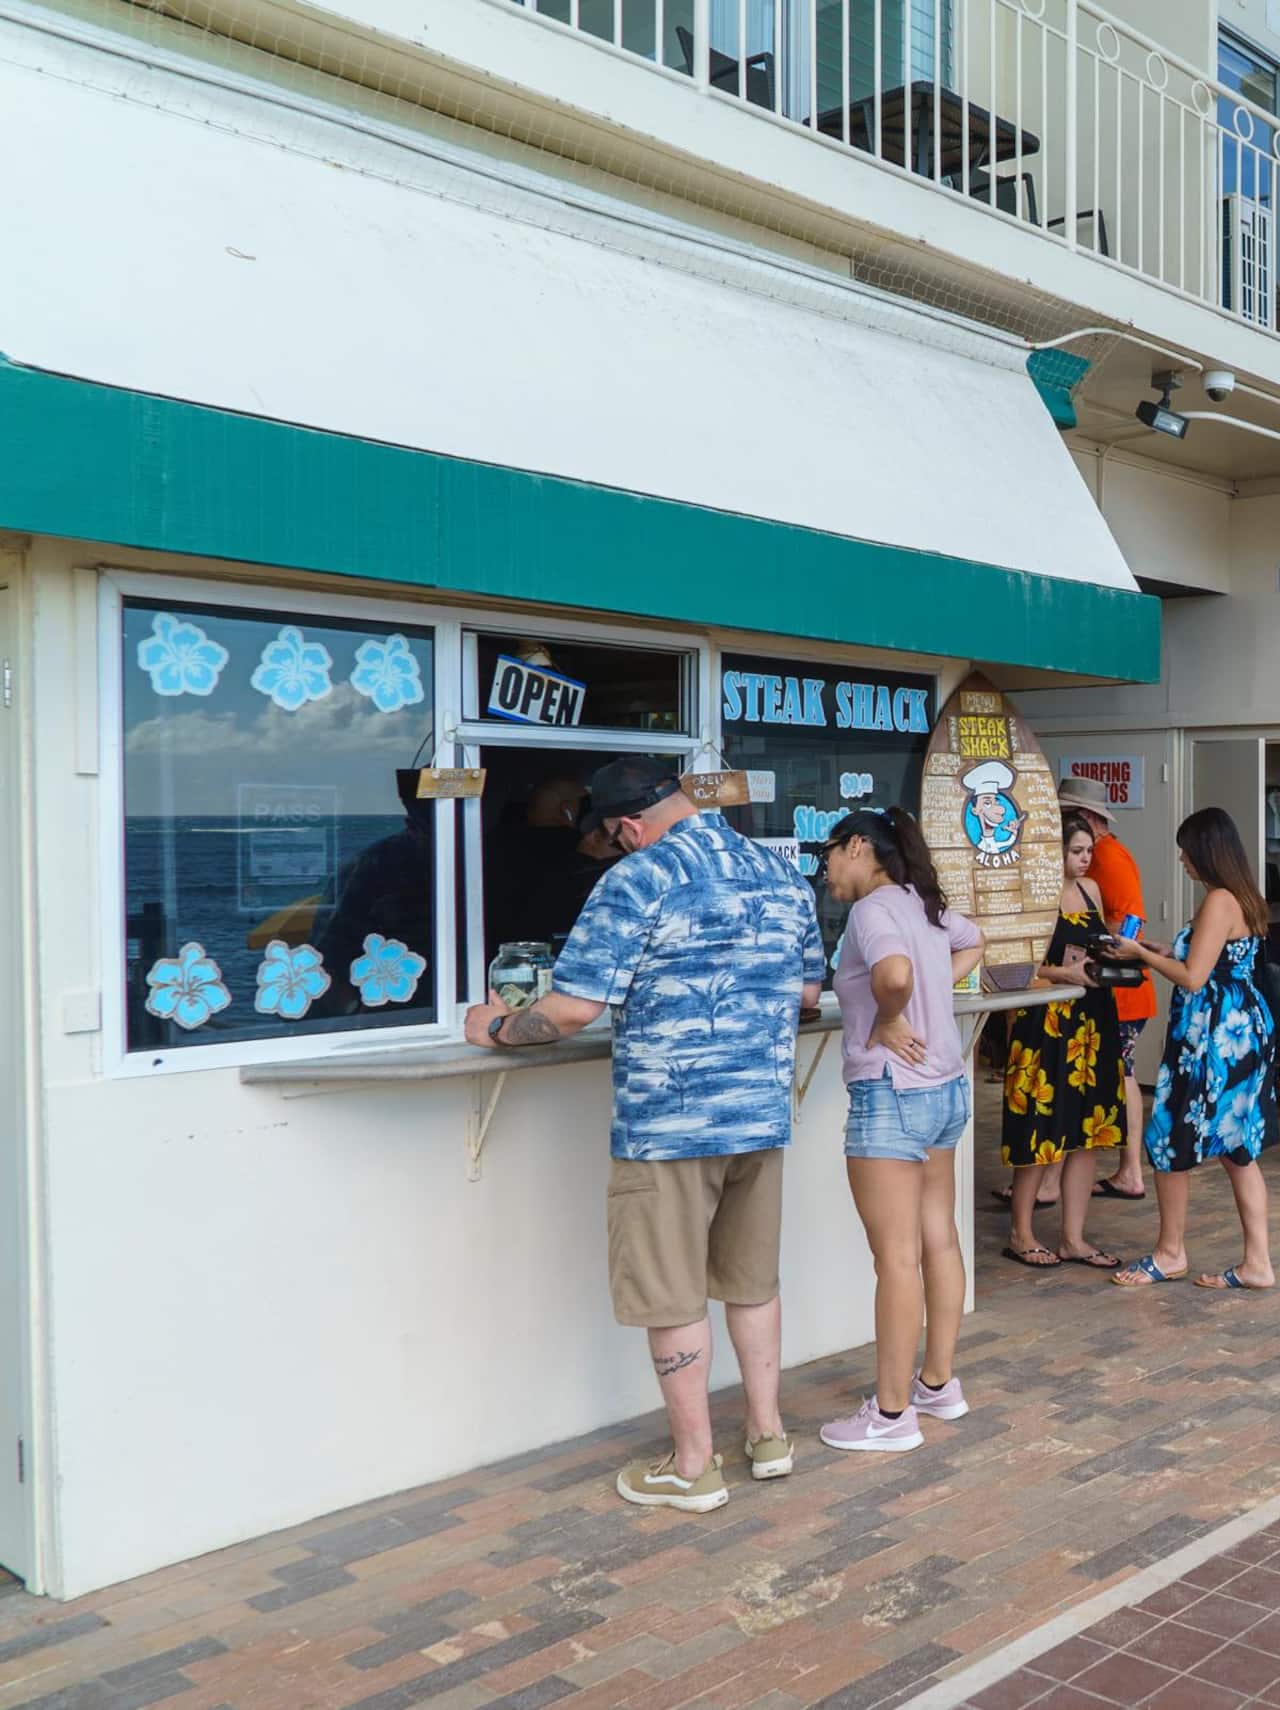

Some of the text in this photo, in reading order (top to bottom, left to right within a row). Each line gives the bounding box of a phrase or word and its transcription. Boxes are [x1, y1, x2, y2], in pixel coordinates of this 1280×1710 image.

[499, 666, 579, 725] OPEN
[723, 671, 930, 733] STEAK SHACK
[966, 694, 996, 706] MENU
[959, 716, 1007, 736] STEAK
[961, 736, 1010, 758] SHACK
[1071, 762, 1131, 782] SURFING
[976, 849, 1020, 868] ALOHA
